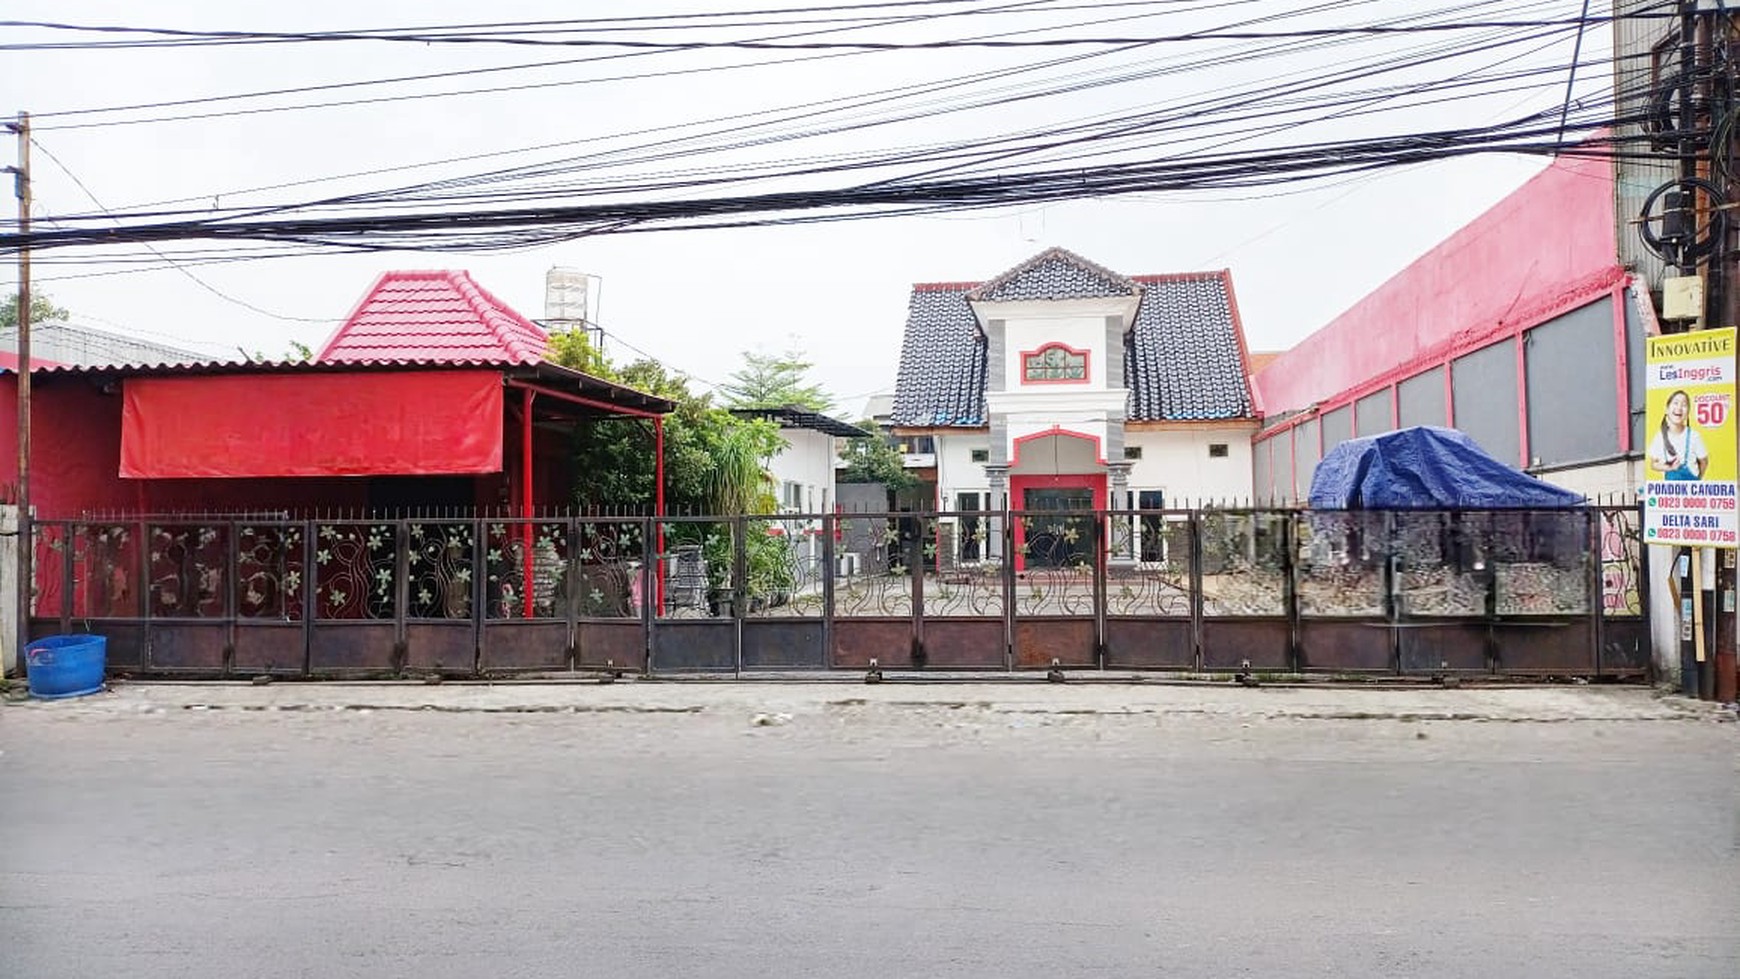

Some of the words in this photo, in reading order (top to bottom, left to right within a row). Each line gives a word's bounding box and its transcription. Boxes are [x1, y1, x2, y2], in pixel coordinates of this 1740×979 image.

[1660, 366, 1721, 380] LesInggris
[1648, 483, 1688, 495] PONDOK
[1691, 484, 1735, 496] CANDRA
[1662, 515, 1691, 527] DELTA
[1694, 516, 1719, 528] SARI
